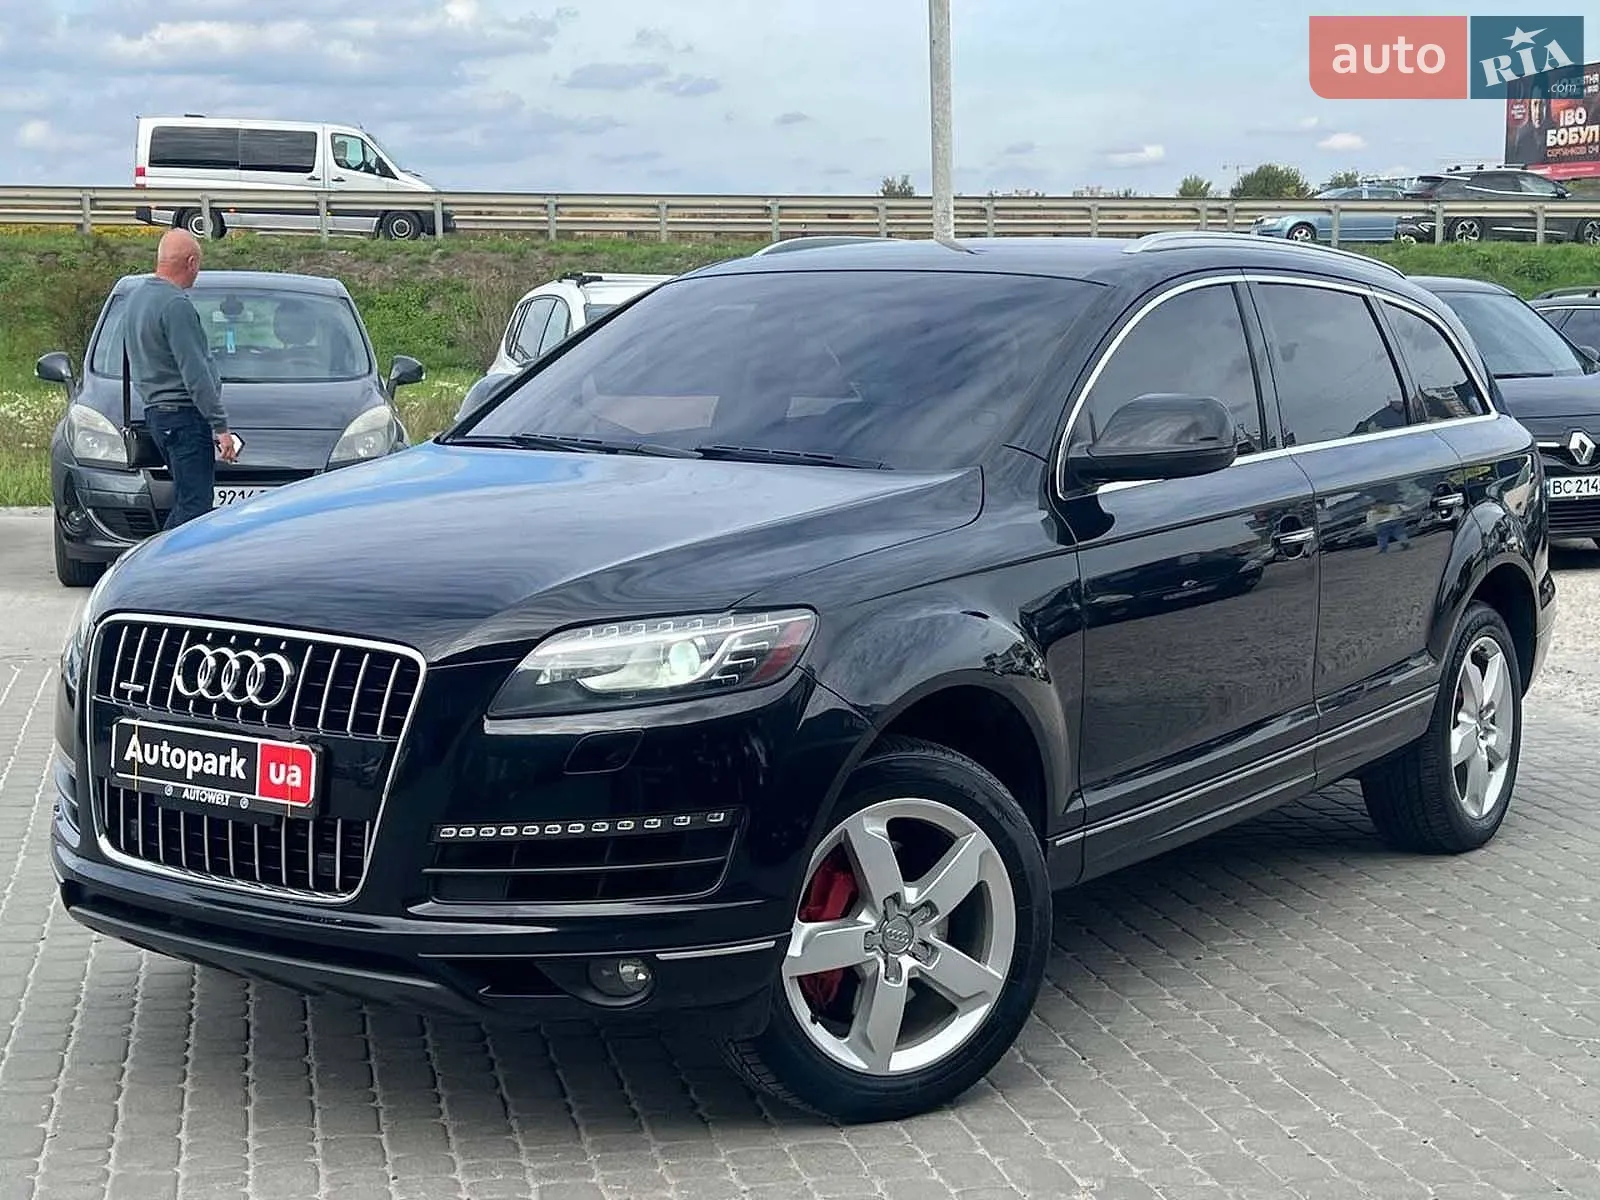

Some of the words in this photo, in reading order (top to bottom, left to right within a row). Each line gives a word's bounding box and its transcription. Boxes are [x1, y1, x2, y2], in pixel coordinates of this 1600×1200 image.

[1559, 107, 1587, 127] ІВО
[1546, 125, 1600, 147] БОБУЛ
[1553, 480, 1573, 495] BC
[1575, 478, 1600, 493] 214
[123, 733, 248, 780] Autopark
[268, 761, 303, 788] ua
[182, 788, 230, 806] AUTOWELT
